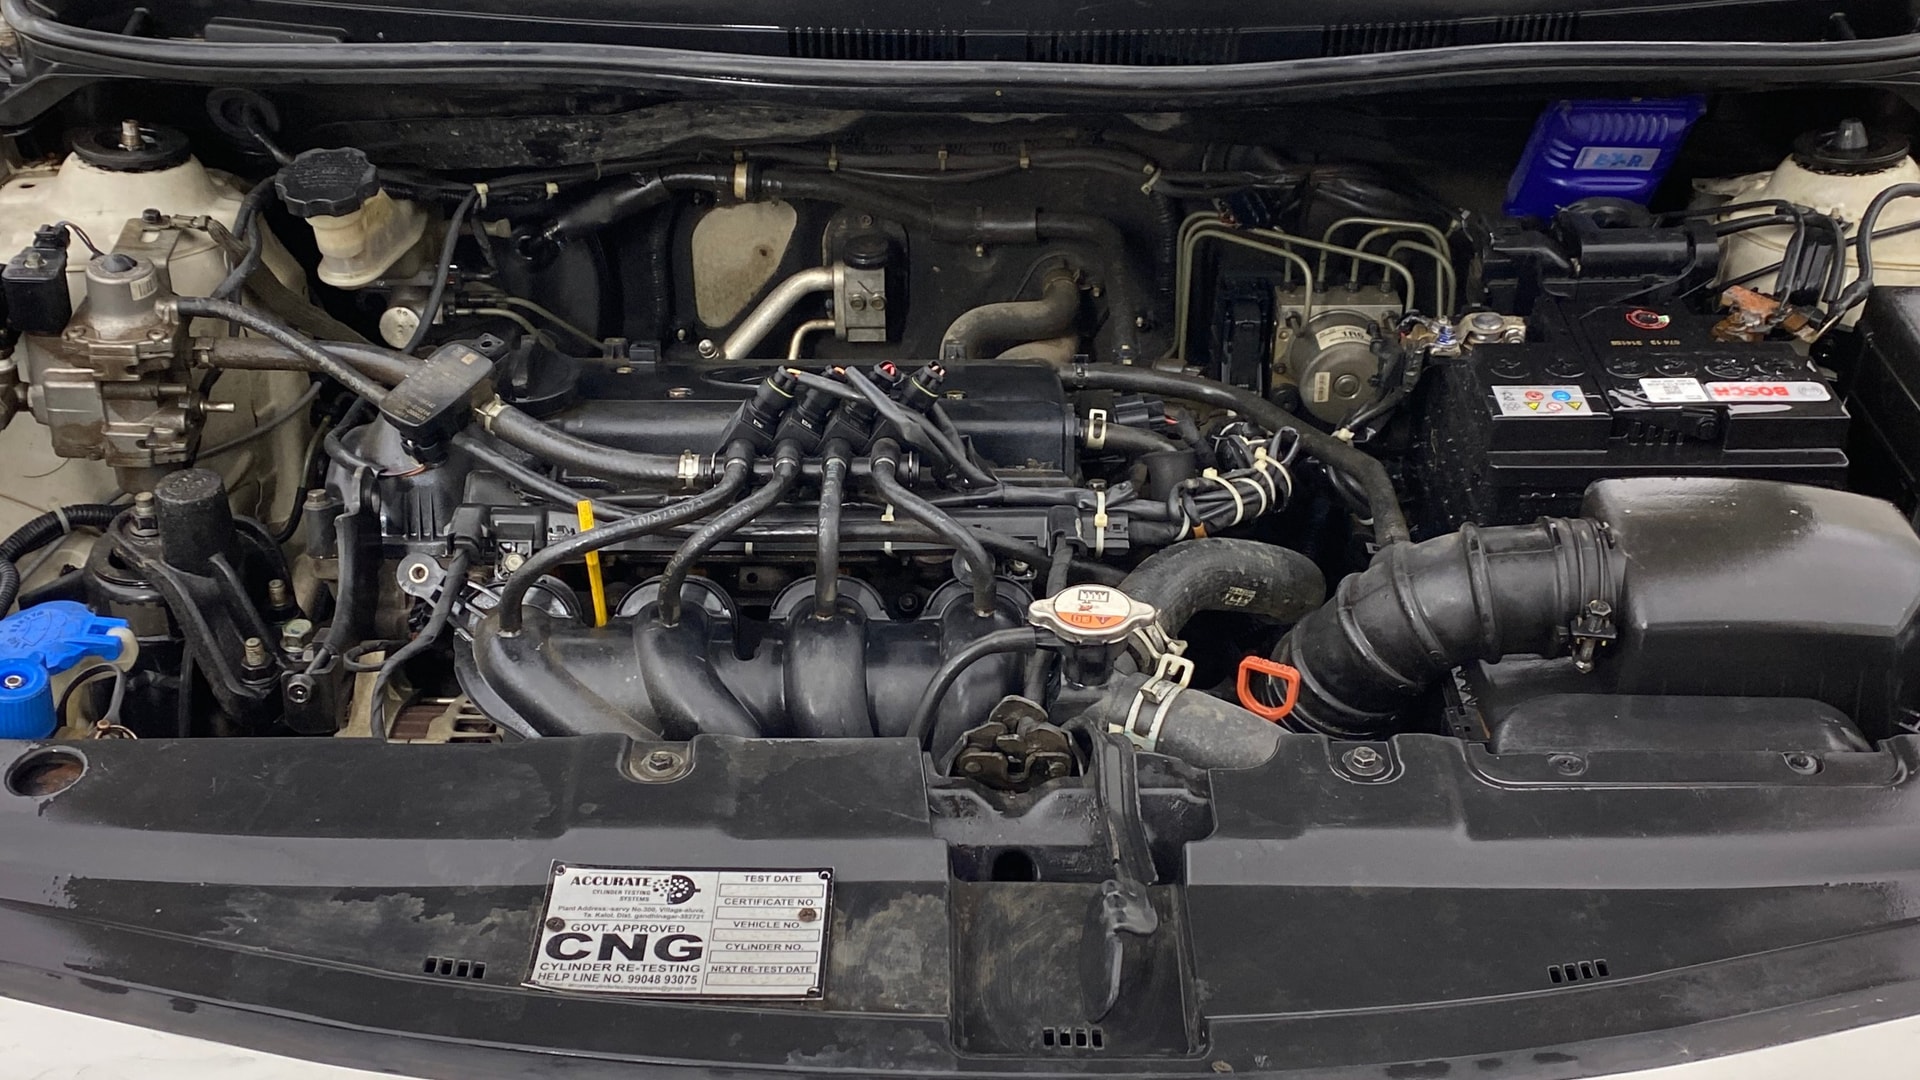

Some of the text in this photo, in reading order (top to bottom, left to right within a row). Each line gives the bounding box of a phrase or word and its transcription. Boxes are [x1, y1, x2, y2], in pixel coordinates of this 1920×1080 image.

[1712, 385, 1790, 397] BOSCH
[570, 875, 651, 886] ACCURATE
[774, 875, 802, 883] DATE
[570, 923, 685, 932] GOVT. APPROVED
[545, 932, 703, 962] CNG
[784, 943, 804, 951] NO.
[539, 962, 701, 973] CYLINDER RE-TESTING
[711, 965, 738, 973] NEXT
[785, 966, 813, 974] DATE
[537, 972, 698, 985] HELP LINE NO. 99048 93075
